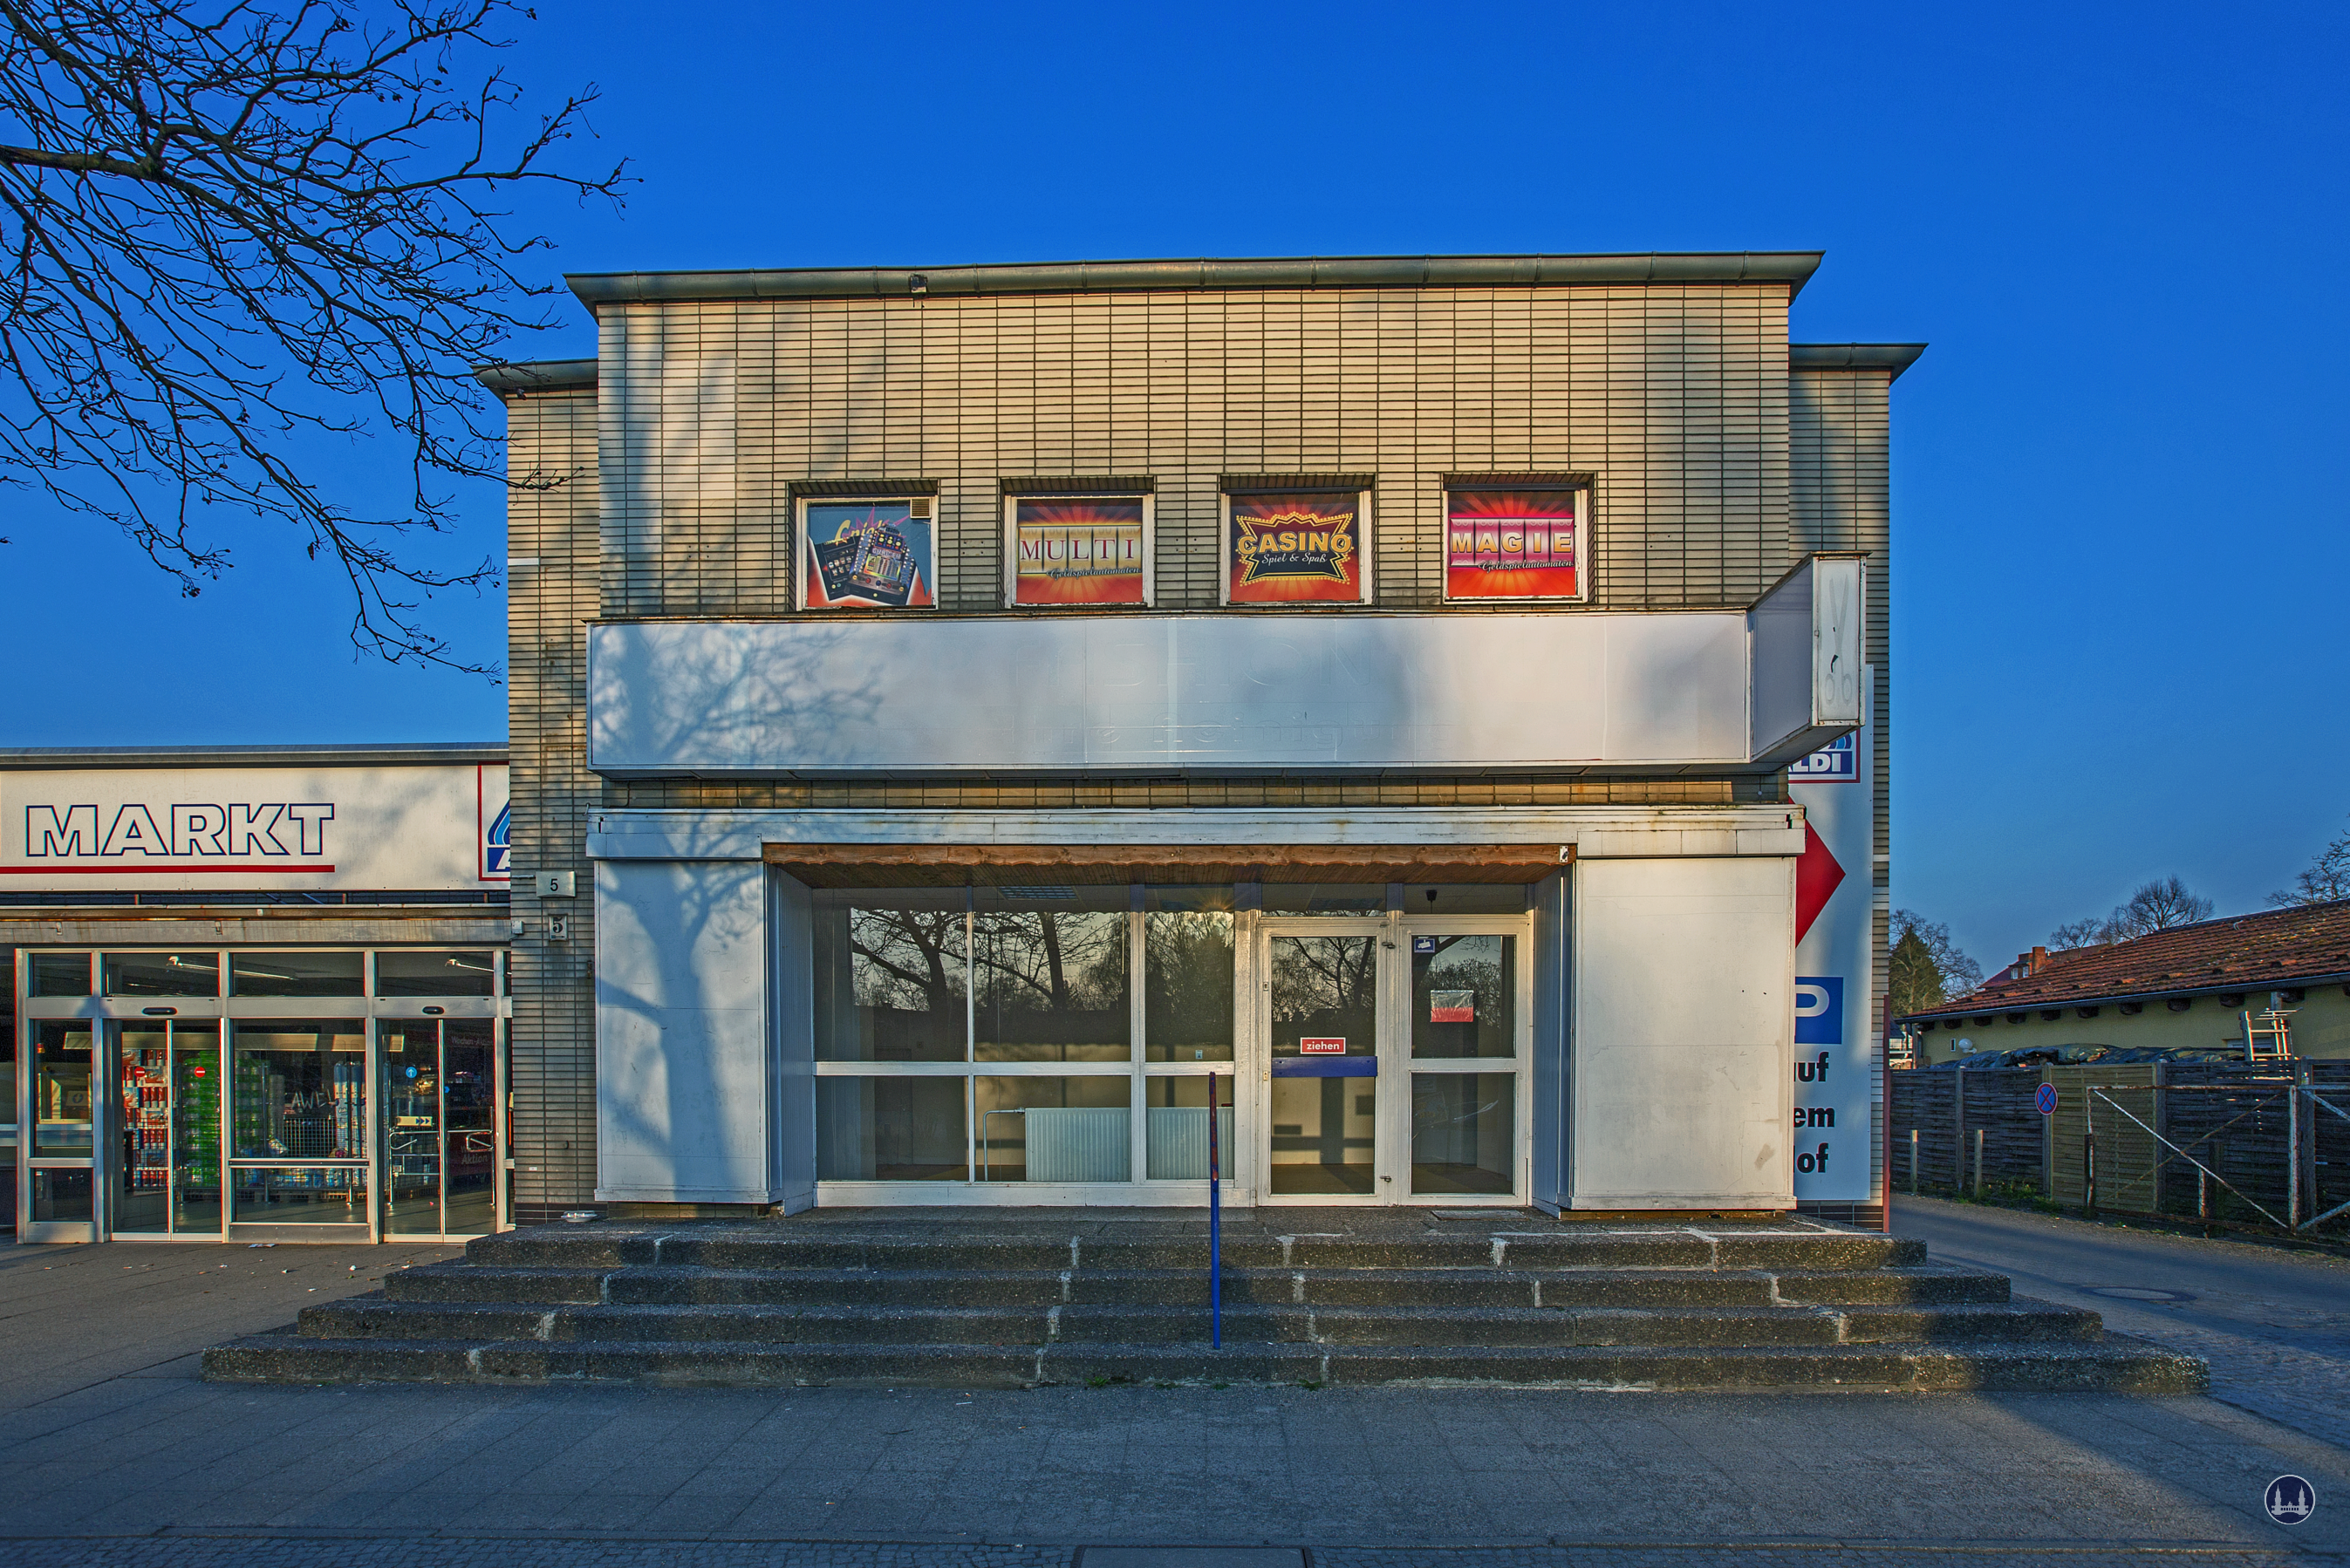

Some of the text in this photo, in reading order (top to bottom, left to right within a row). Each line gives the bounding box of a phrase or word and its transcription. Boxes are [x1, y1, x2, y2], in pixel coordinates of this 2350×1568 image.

[1020, 538, 1135, 561] MULTI
[1237, 531, 1353, 556] CASINO
[1451, 531, 1573, 554] MAGIE
[1261, 552, 1328, 566] Spiel & Spaß
[1480, 560, 1574, 574] Geldspielautomaten
[1049, 566, 1140, 581] Geldspielautomaten
[25, 802, 336, 857] MARKT
[550, 878, 558, 891] 5
[552, 917, 564, 933] 5
[1306, 1040, 1340, 1050] ziehen
[1793, 1051, 1829, 1082] uf
[1793, 1107, 1835, 1128] em
[1793, 1142, 1829, 1173] of
